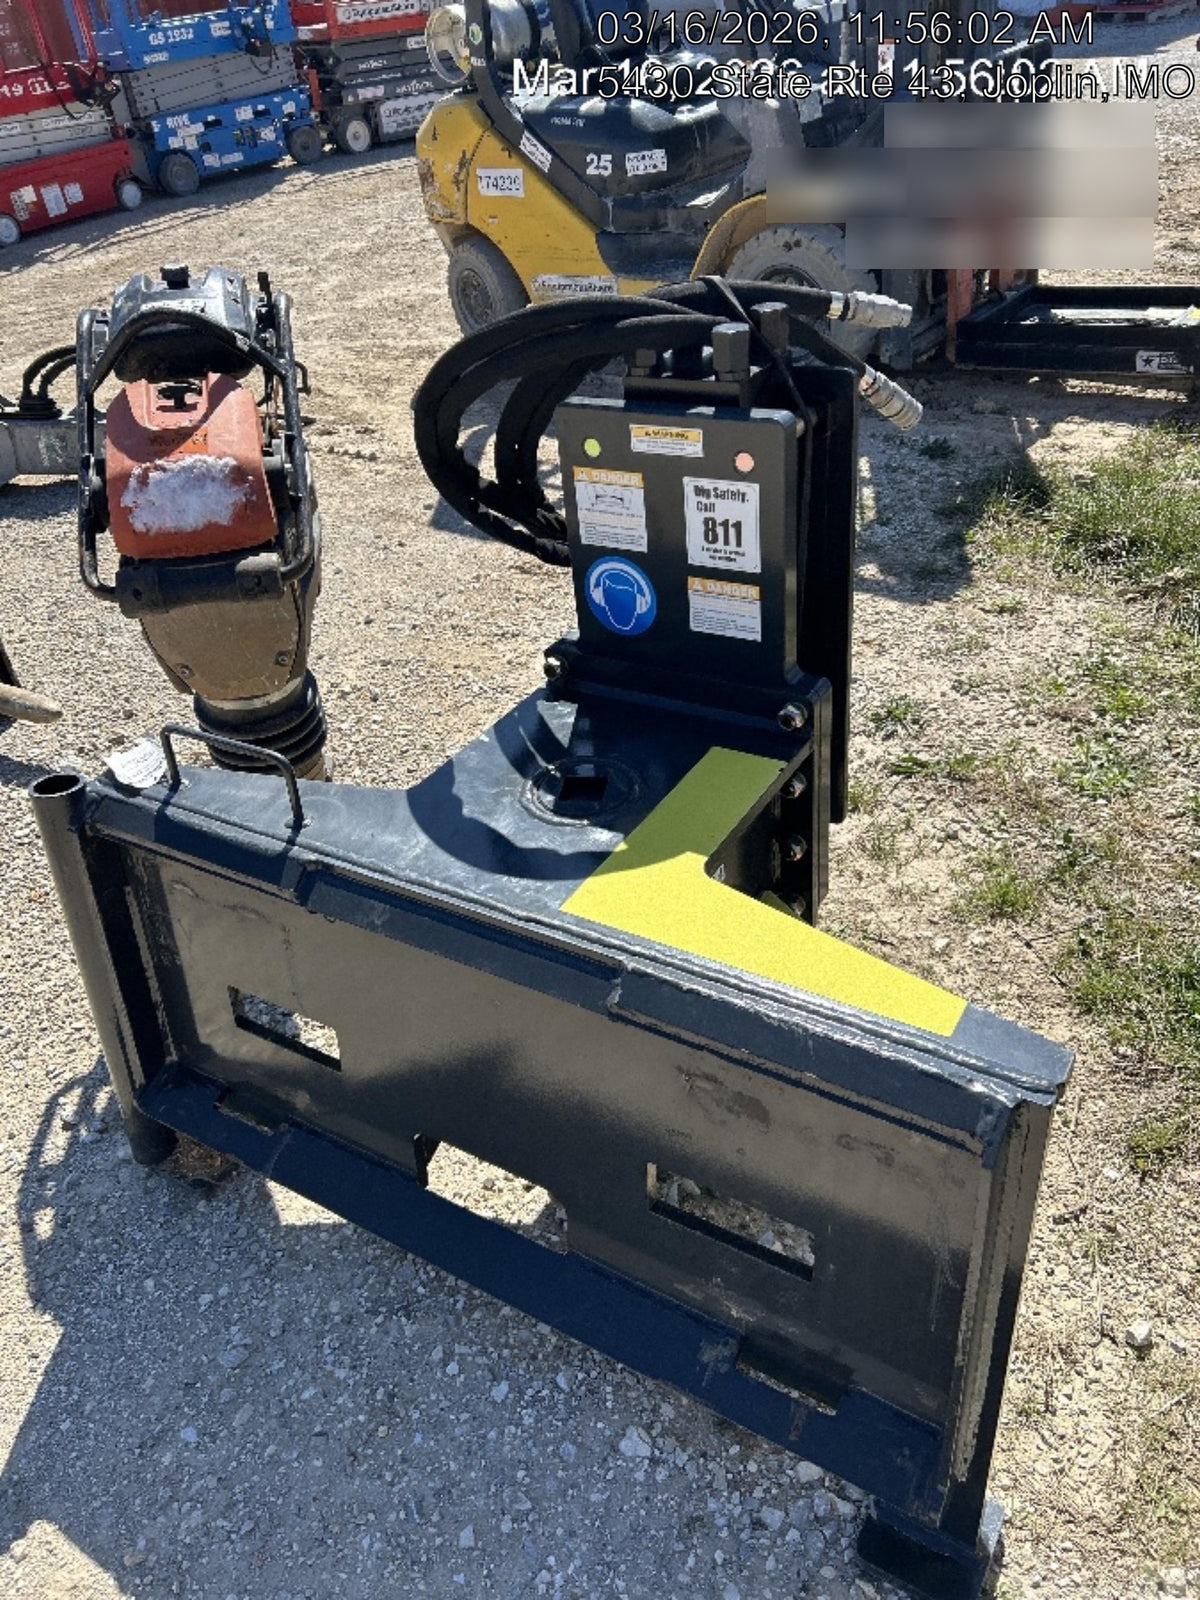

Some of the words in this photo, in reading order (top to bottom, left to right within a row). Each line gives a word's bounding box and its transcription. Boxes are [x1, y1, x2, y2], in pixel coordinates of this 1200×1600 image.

[586, 153, 613, 176] 25
[693, 485, 711, 500] Dig
[712, 487, 750, 504] Safely.
[696, 501, 716, 513] Call
[702, 516, 742, 548] 811
